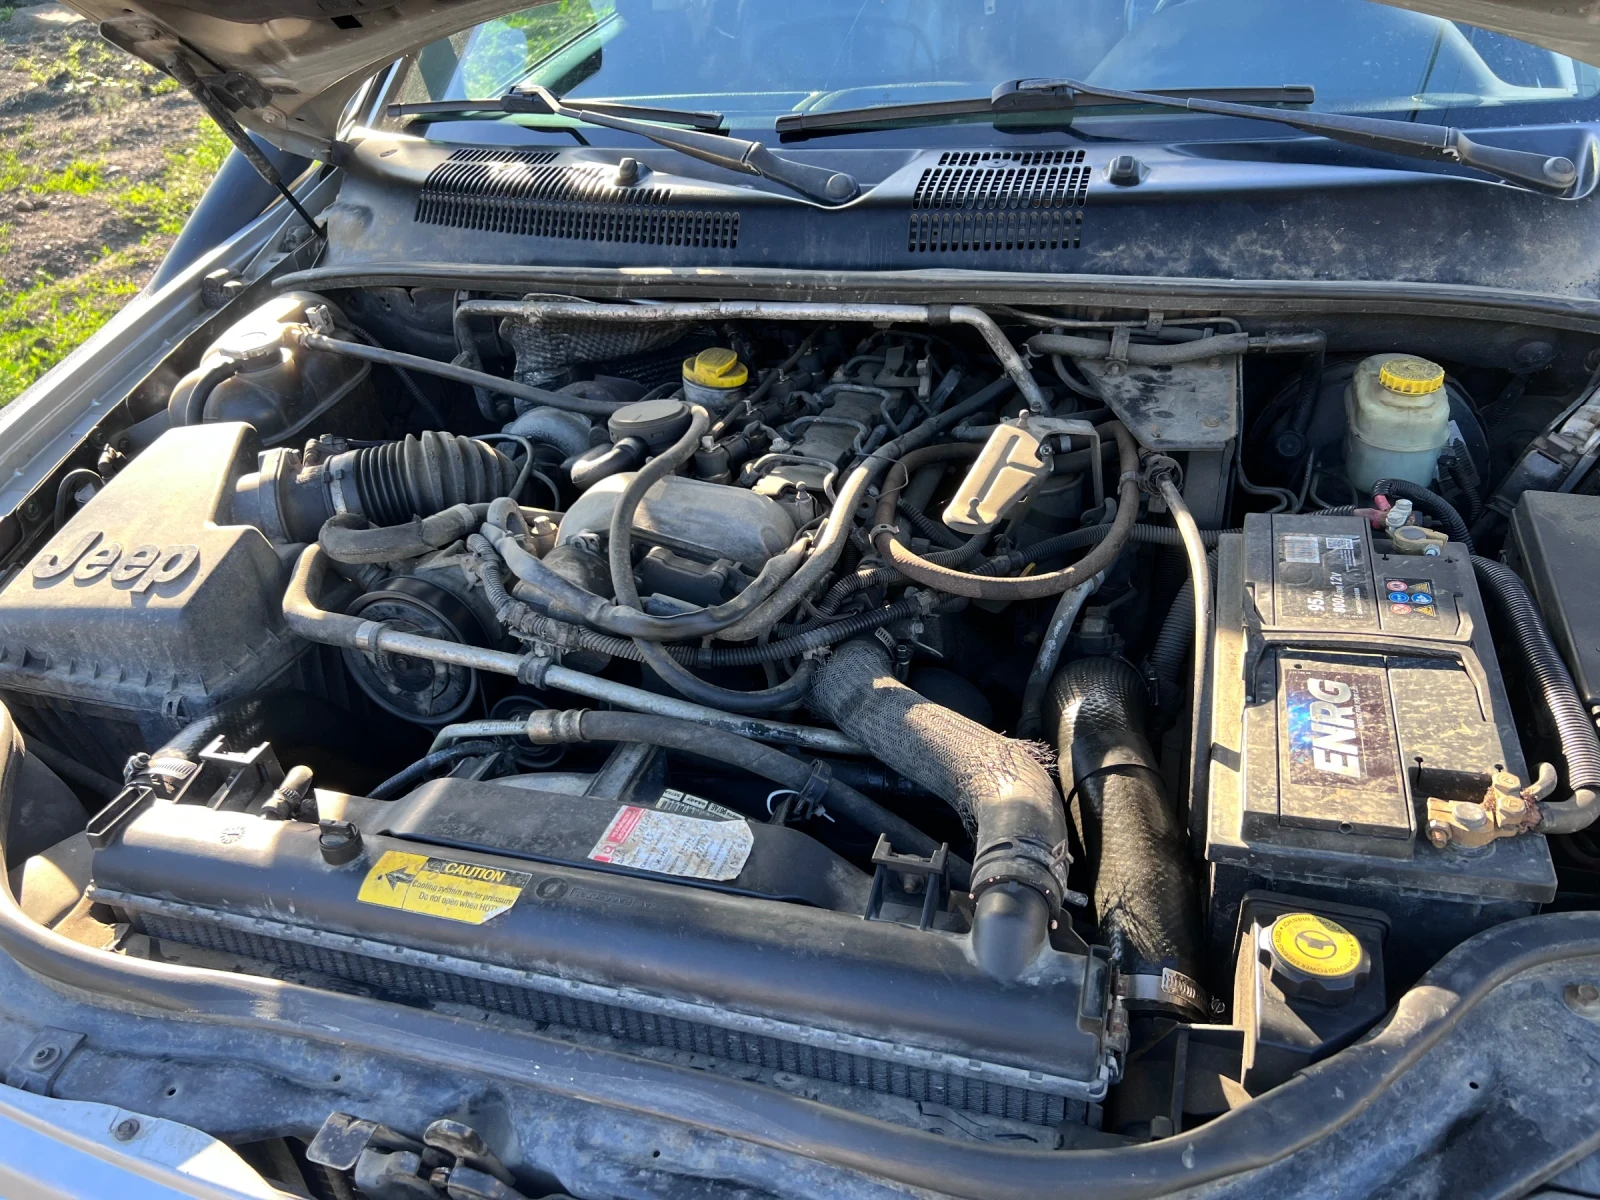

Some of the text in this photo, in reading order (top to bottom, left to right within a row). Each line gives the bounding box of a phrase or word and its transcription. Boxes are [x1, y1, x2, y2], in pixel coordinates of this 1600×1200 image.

[32, 531, 199, 593] Jeep
[1307, 678, 1360, 778] ENRG
[445, 862, 506, 882] CAUTION
[412, 880, 514, 906] Cooling system under pressure
[419, 892, 427, 900] Do
[430, 894, 442, 902] not
[442, 897, 458, 907] open
[460, 900, 478, 910] when
[1277, 944, 1300, 966] STEERING
[1302, 964, 1328, 974] POWER
